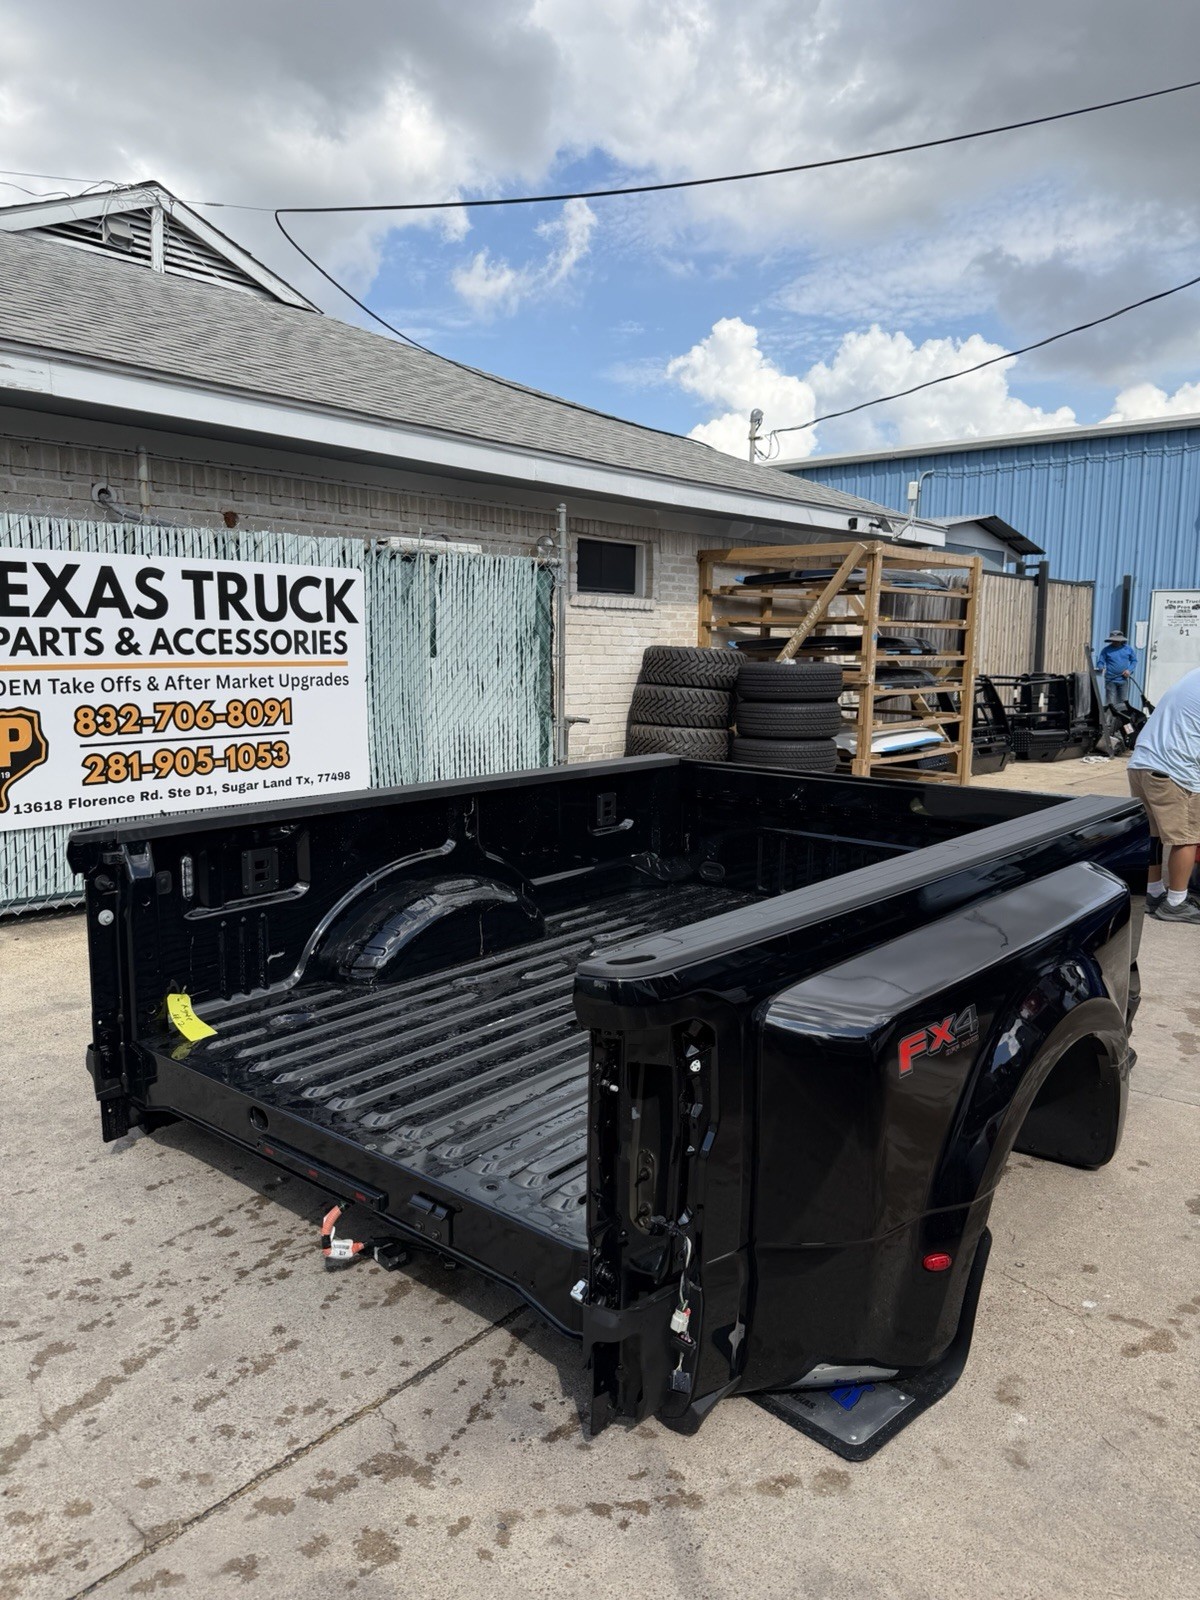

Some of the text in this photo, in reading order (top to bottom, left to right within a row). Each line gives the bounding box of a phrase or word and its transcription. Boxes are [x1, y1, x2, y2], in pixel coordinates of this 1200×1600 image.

[181, 570, 359, 624] TRUCK
[115, 627, 142, 656] &
[149, 628, 348, 656] ACCESSORIES
[48, 677, 95, 694] Take
[101, 676, 142, 693] Offs
[147, 676, 159, 691] &
[165, 675, 211, 691] After
[217, 674, 274, 689] Market
[279, 673, 349, 690] Upgrades
[74, 697, 292, 737] 832-706-8091
[81, 740, 290, 786] 281-905-1053
[14, 771, 351, 814] 13618 Florence Rd. Ste D1, Sugar Land Tx, 77498
[898, 1004, 979, 1079] FX4
